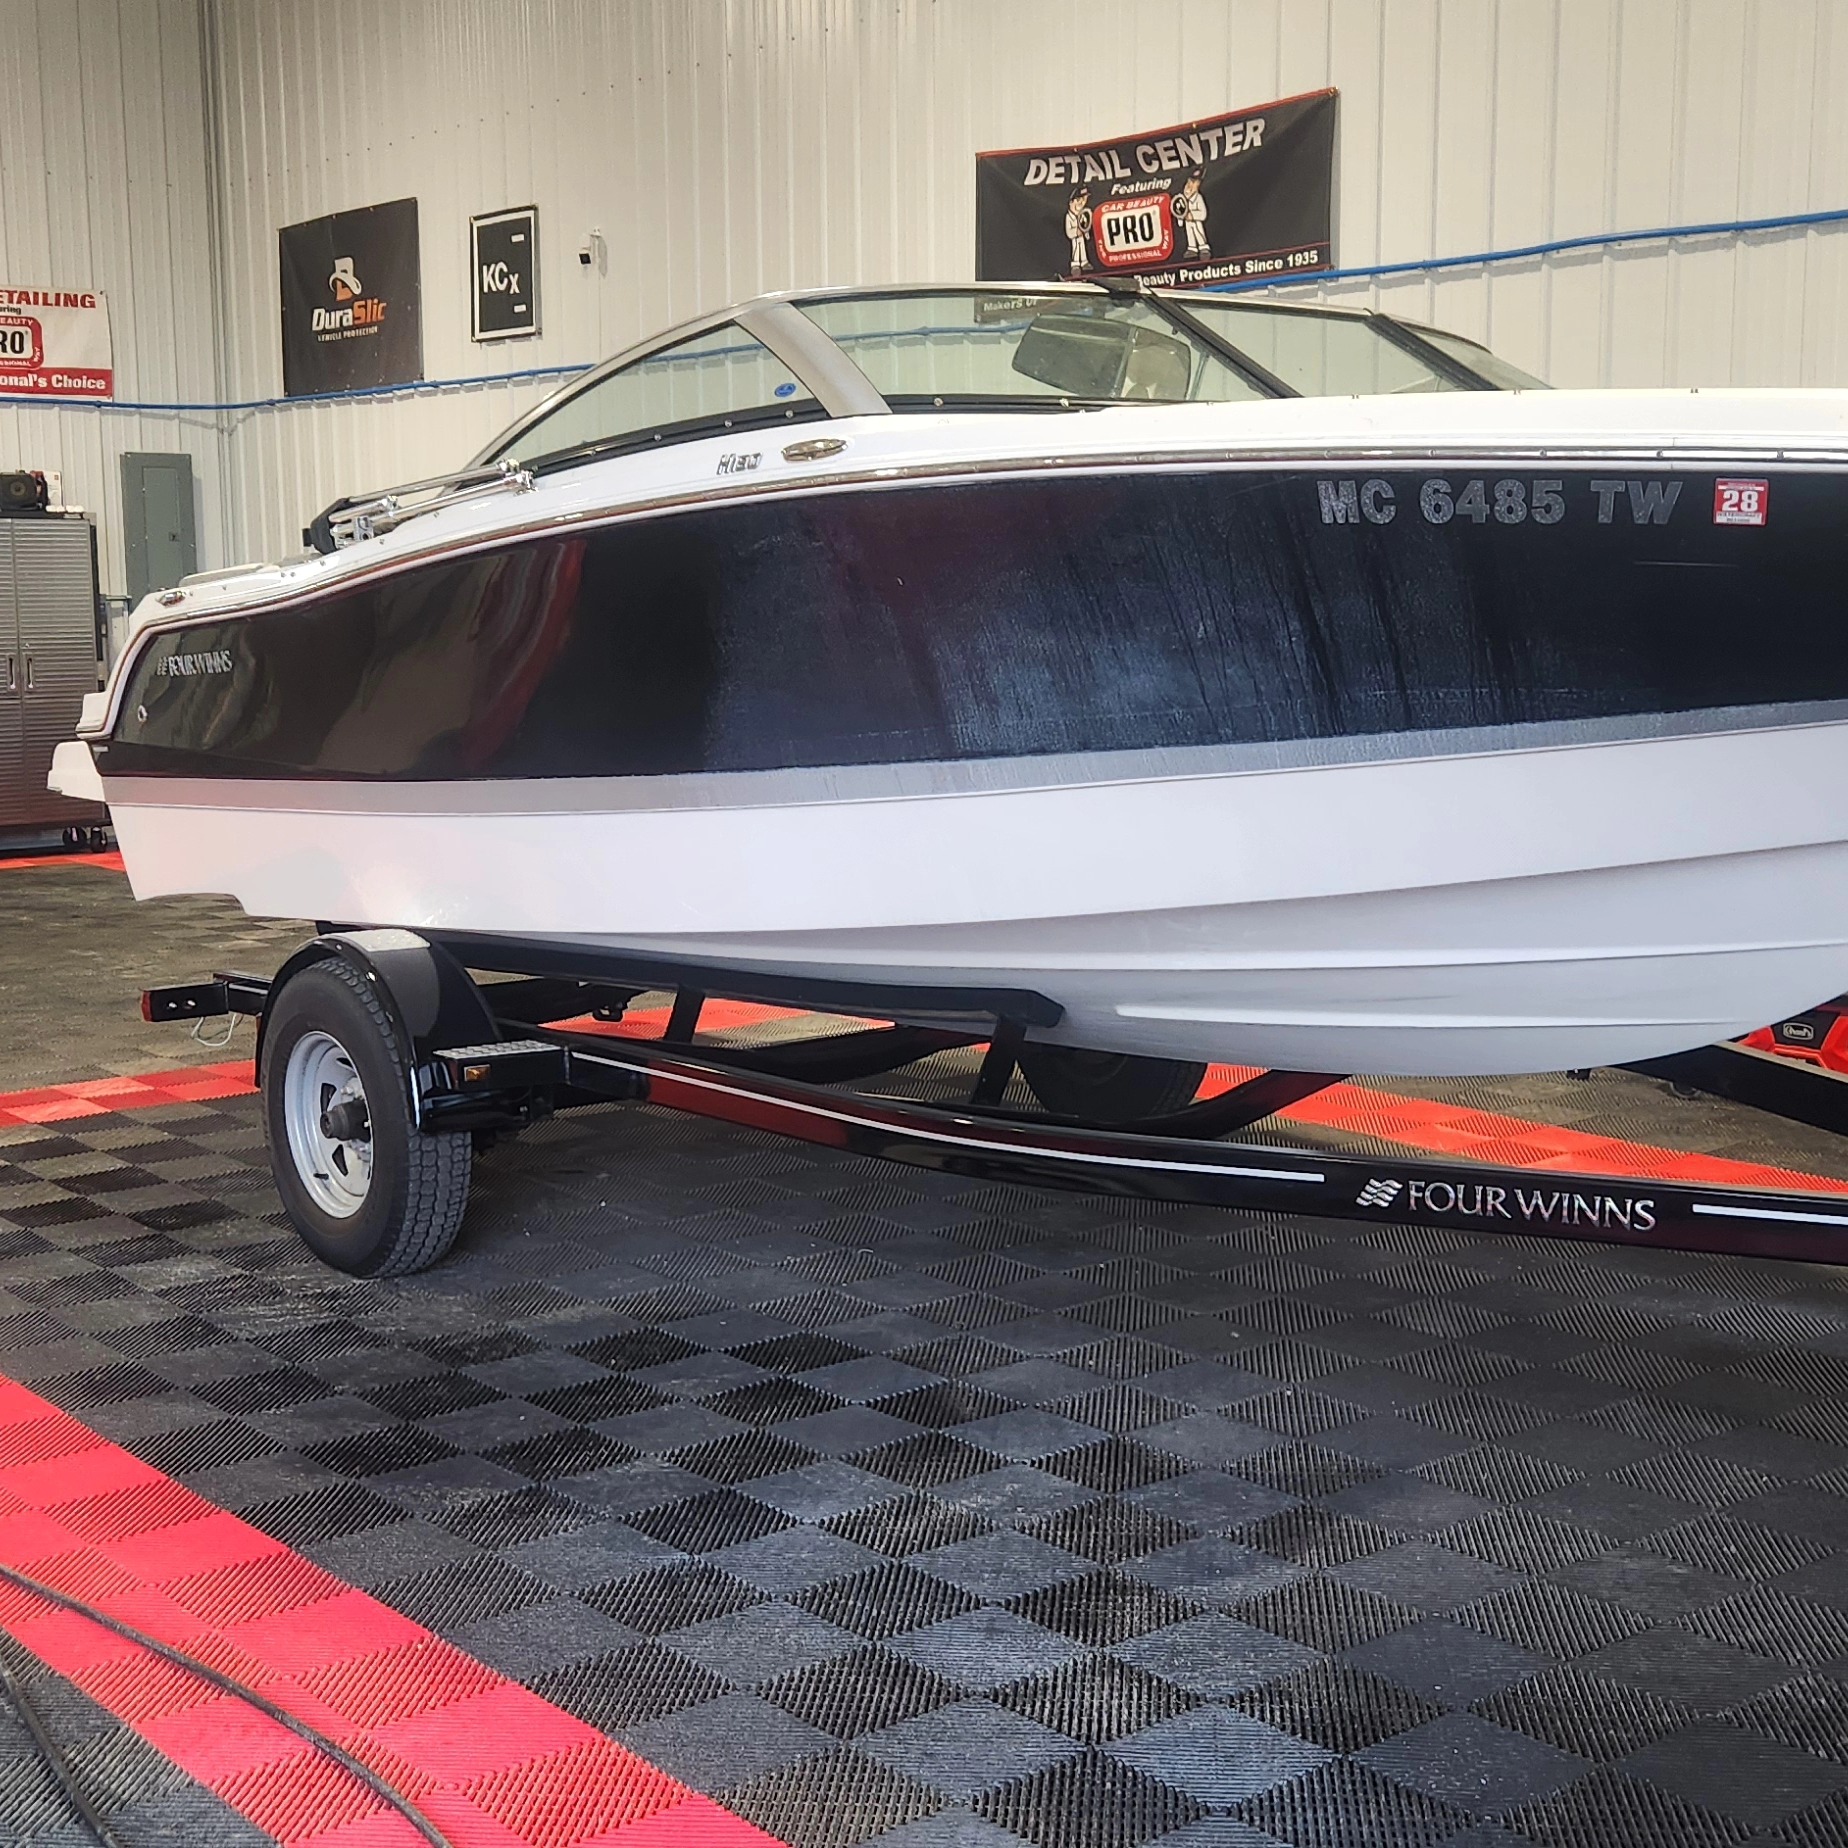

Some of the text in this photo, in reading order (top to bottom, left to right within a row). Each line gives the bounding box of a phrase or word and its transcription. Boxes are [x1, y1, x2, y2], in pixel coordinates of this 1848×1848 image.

[1024, 118, 1266, 186] DETAIL CENTER
[1111, 177, 1172, 196] Featuring
[1126, 196, 1165, 209] BEAUTY
[1106, 212, 1155, 247] PRO
[1179, 265, 1242, 283] Products
[1245, 258, 1283, 274] Since
[1286, 250, 1319, 268] 1935
[311, 298, 387, 331] DuraSlic
[51, 374, 106, 390] Choice
[1316, 479, 1683, 524] MC 6485 TW
[1721, 489, 1759, 512] 28
[1408, 1180, 1656, 1231] FOUR WINNS
